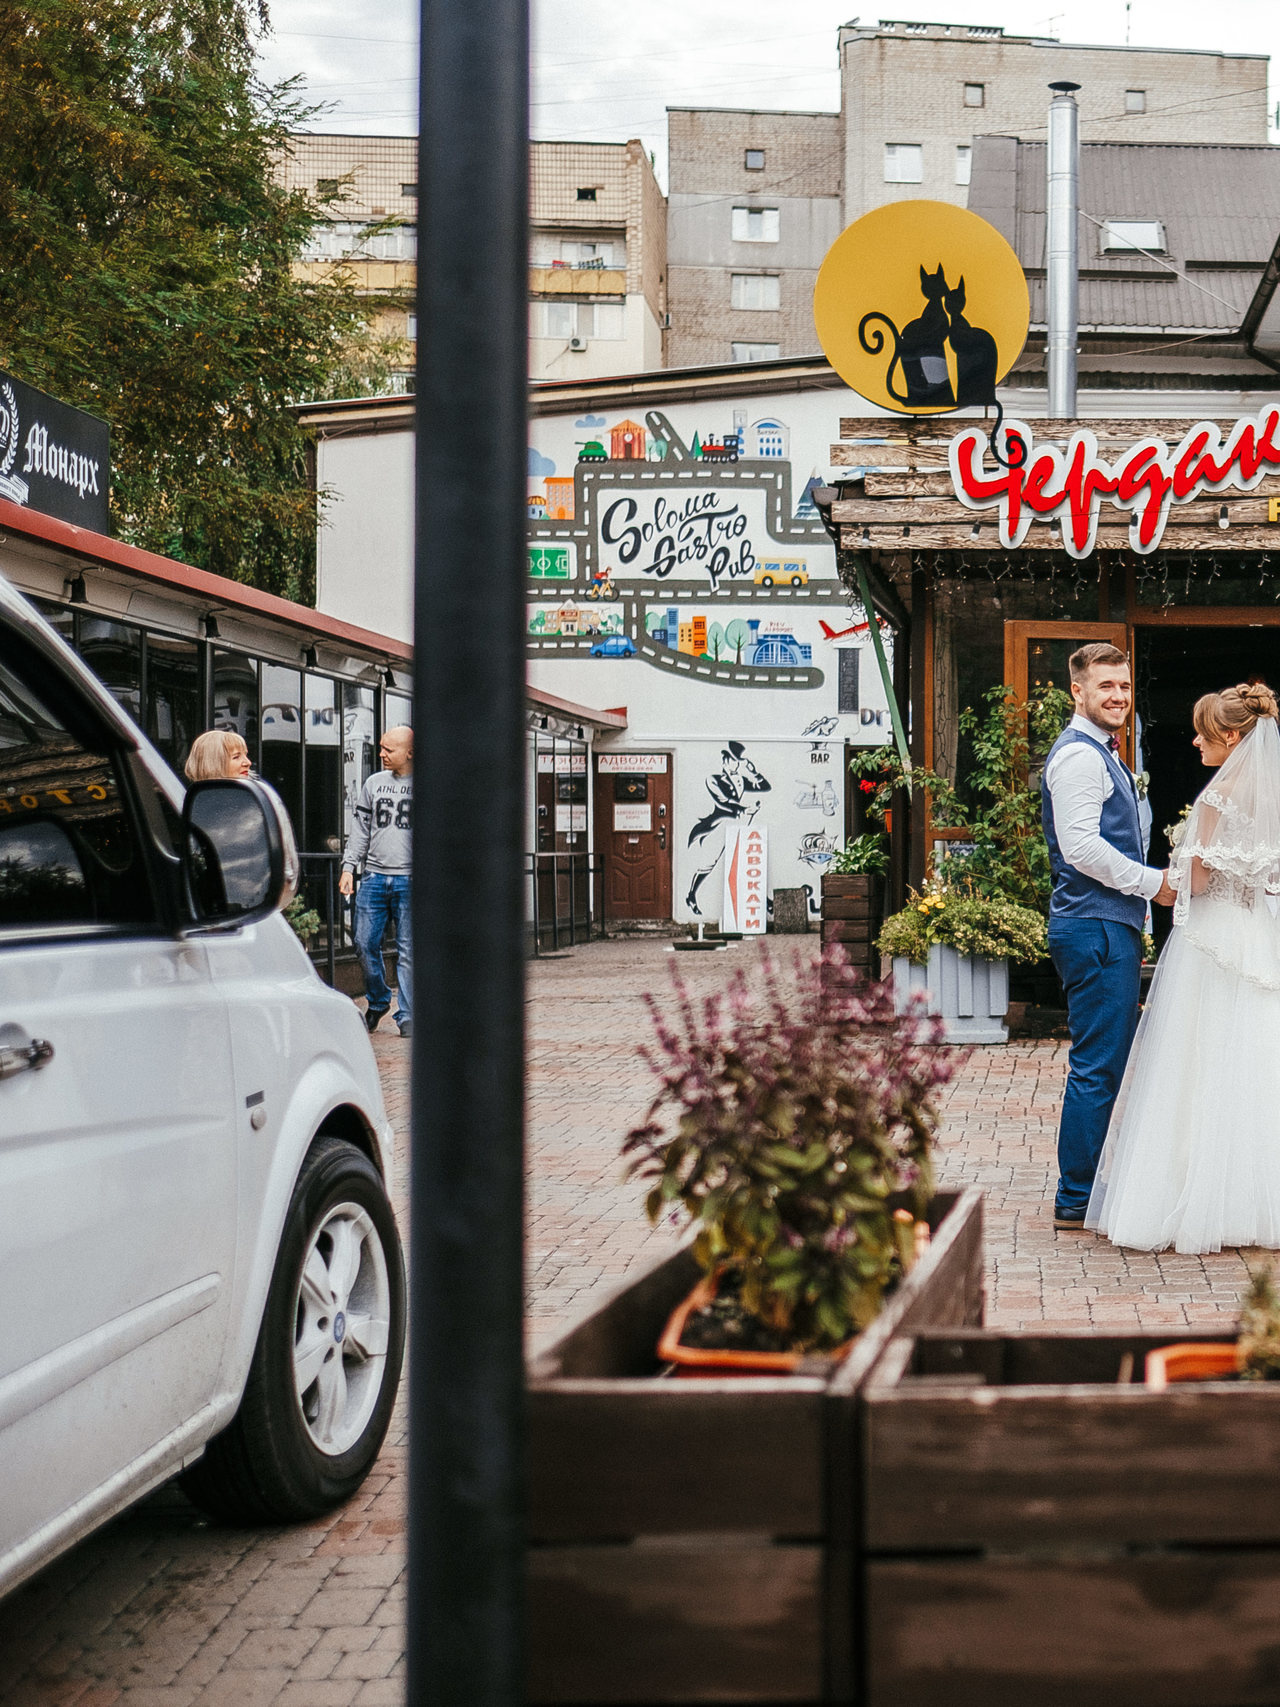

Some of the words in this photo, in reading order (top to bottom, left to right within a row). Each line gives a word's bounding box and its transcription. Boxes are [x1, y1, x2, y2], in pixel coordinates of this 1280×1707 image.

[23, 422, 100, 500] Монарх
[601, 492, 720, 565] Soloma
[599, 754, 665, 767] АДВОКАТ
[810, 752, 830, 764] BAR
[376, 785, 398, 794] ATHL.
[400, 786, 413, 795] DE
[375, 797, 413, 830] 68
[745, 830, 763, 929] АДВОКАТИ
